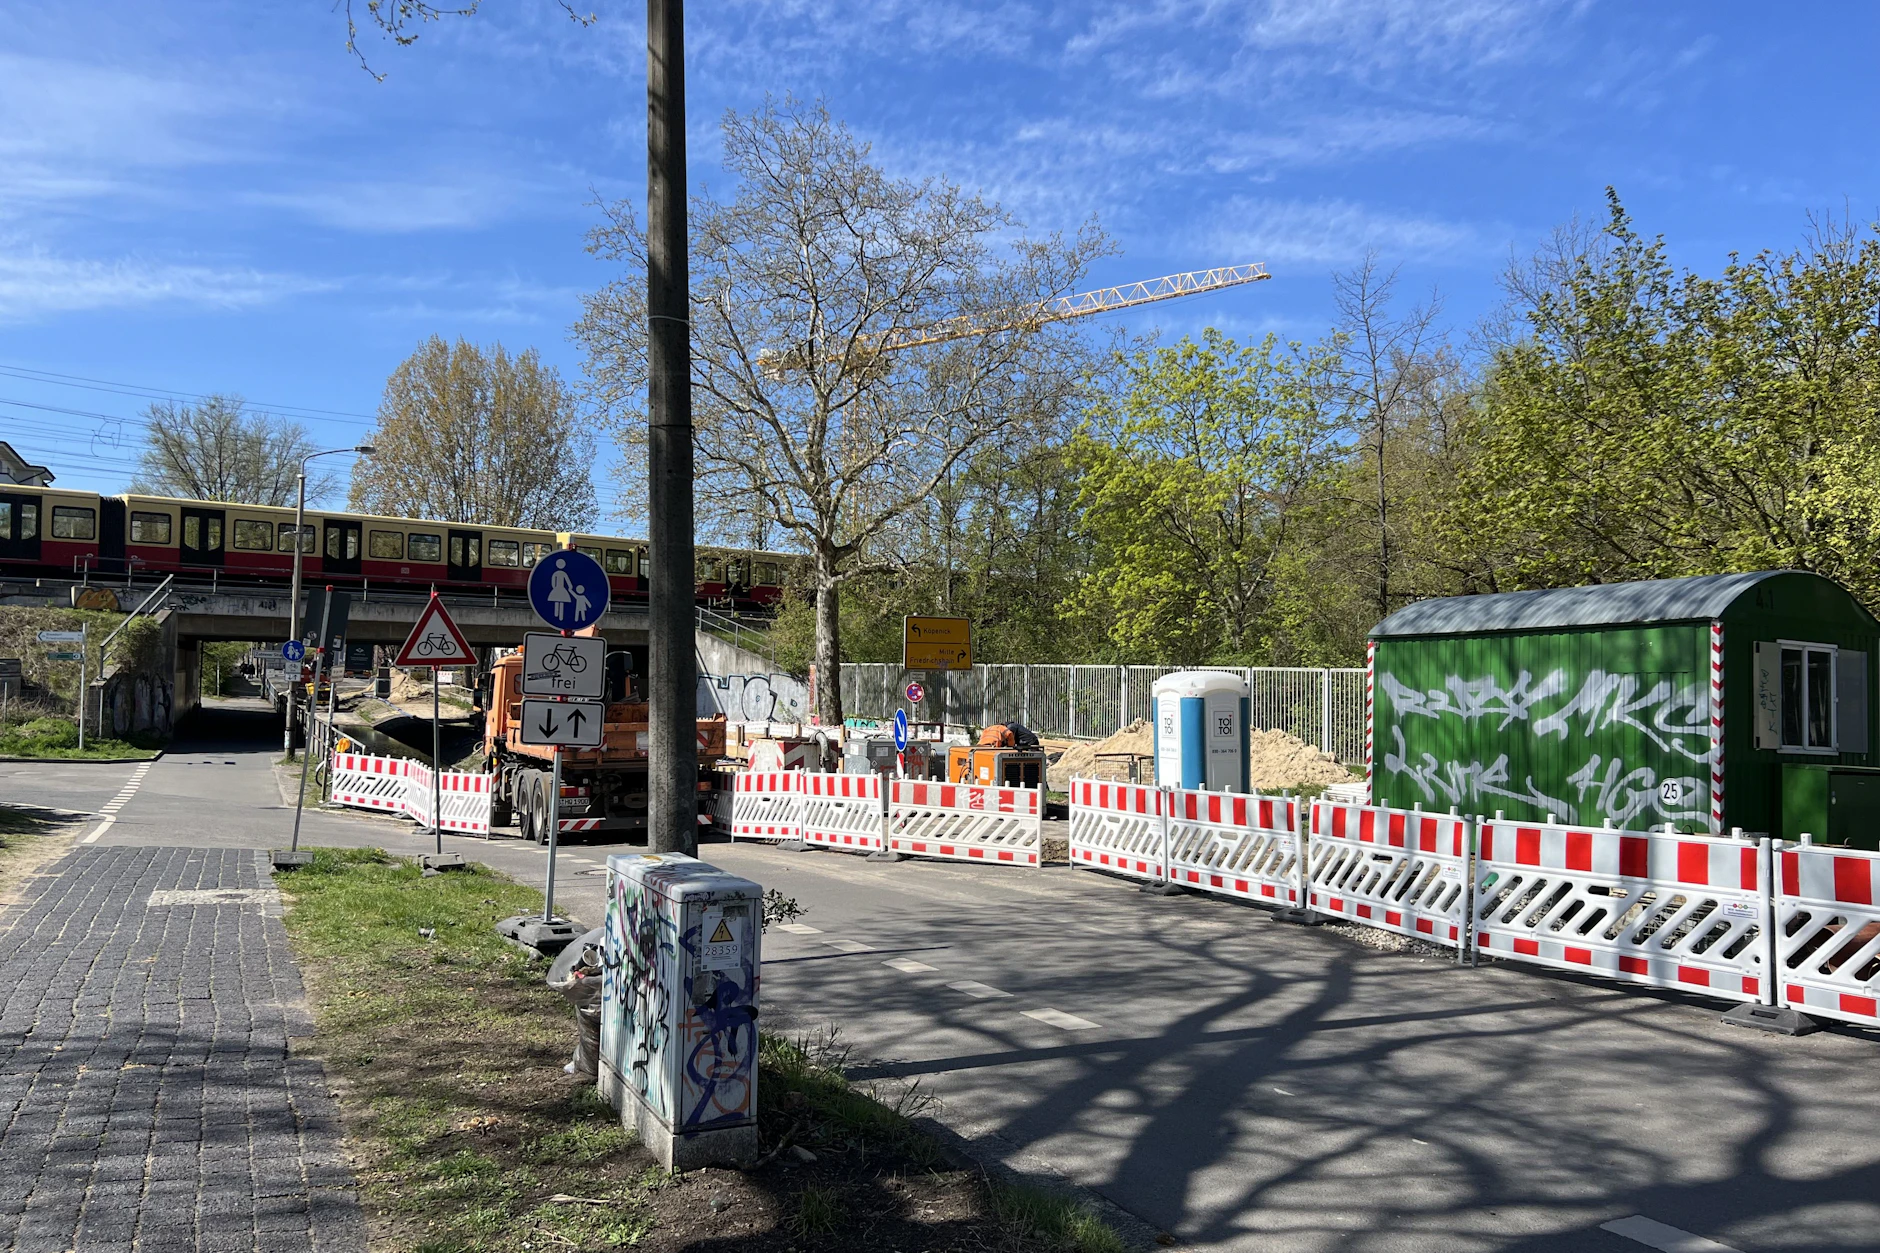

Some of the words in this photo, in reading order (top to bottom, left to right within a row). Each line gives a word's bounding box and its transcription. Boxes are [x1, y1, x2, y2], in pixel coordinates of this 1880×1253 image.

[923, 627, 951, 635] Köpenick
[552, 675, 576, 689] frei
[1218, 718, 1232, 726] TOI
[1218, 726, 1232, 734] TOI
[1663, 783, 1678, 799] 25
[705, 945, 738, 956] 28359
